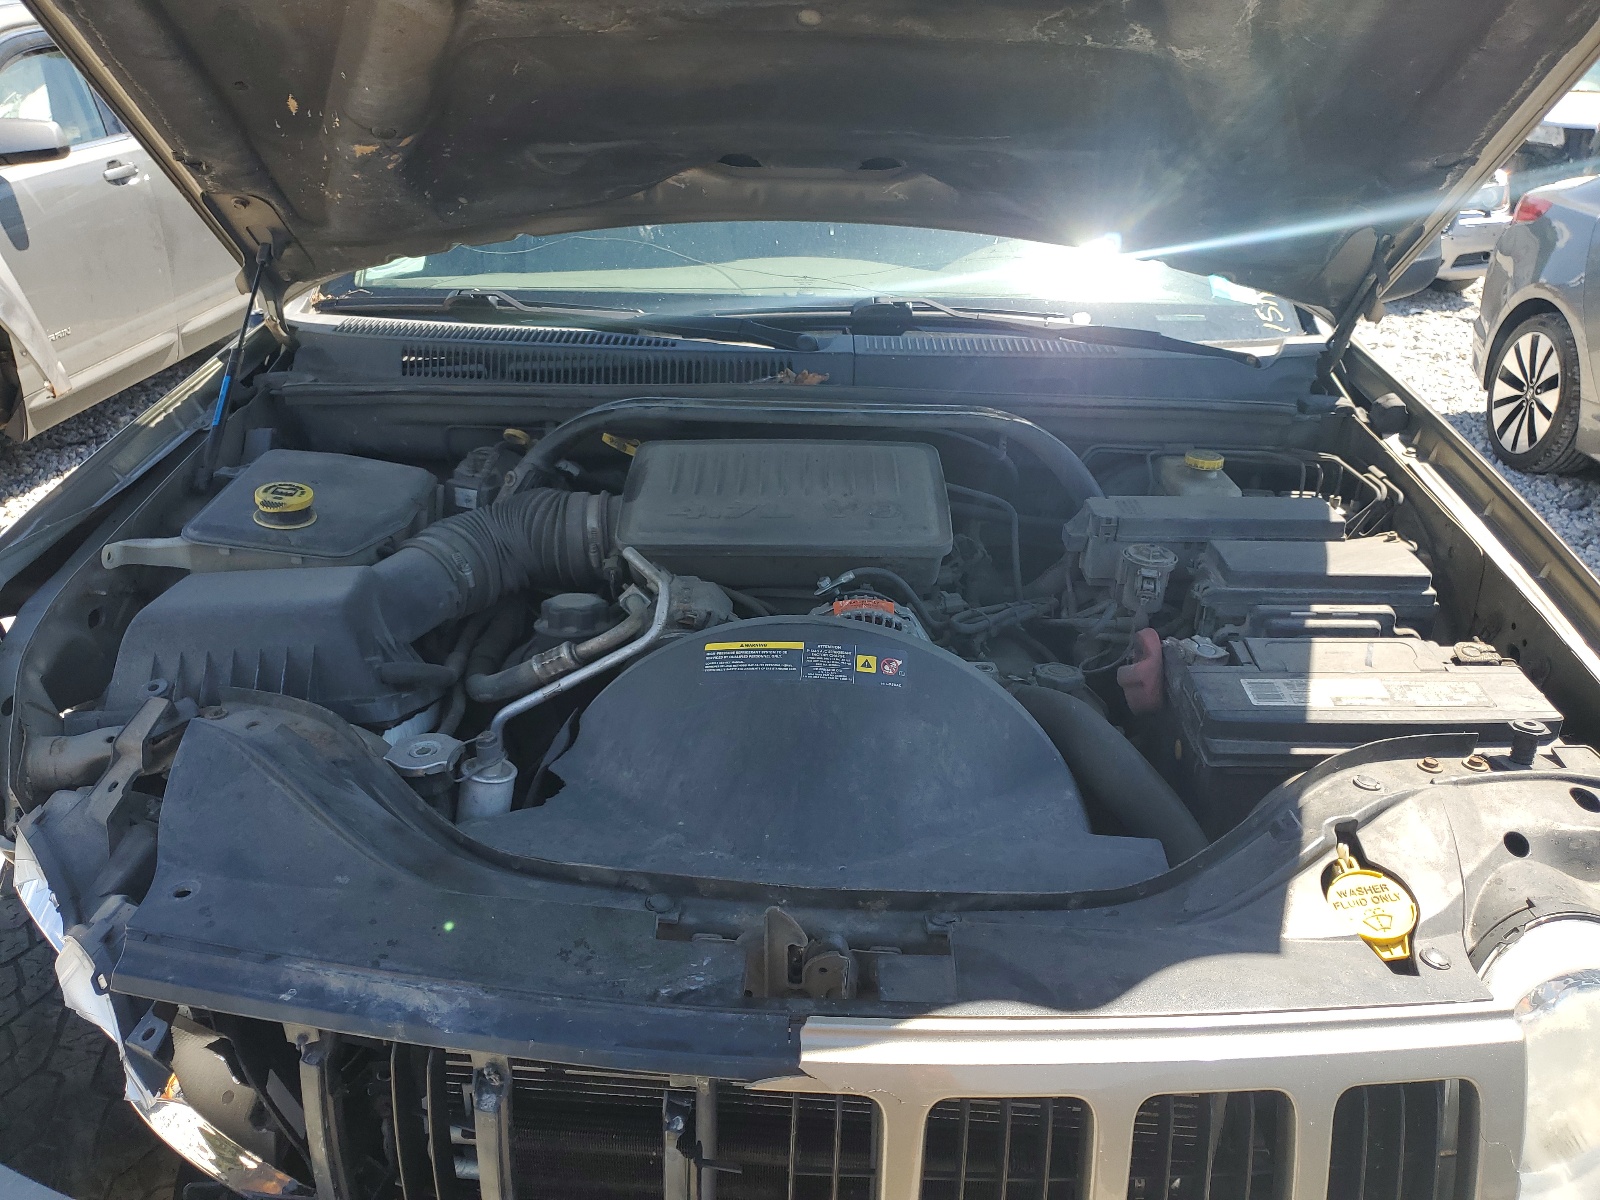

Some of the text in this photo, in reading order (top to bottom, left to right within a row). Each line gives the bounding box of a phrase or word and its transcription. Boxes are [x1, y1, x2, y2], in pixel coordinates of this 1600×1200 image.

[48, 326, 72, 342] RAIN
[1336, 883, 1390, 898] WASHER
[1332, 892, 1401, 911] FLUID ONLY
